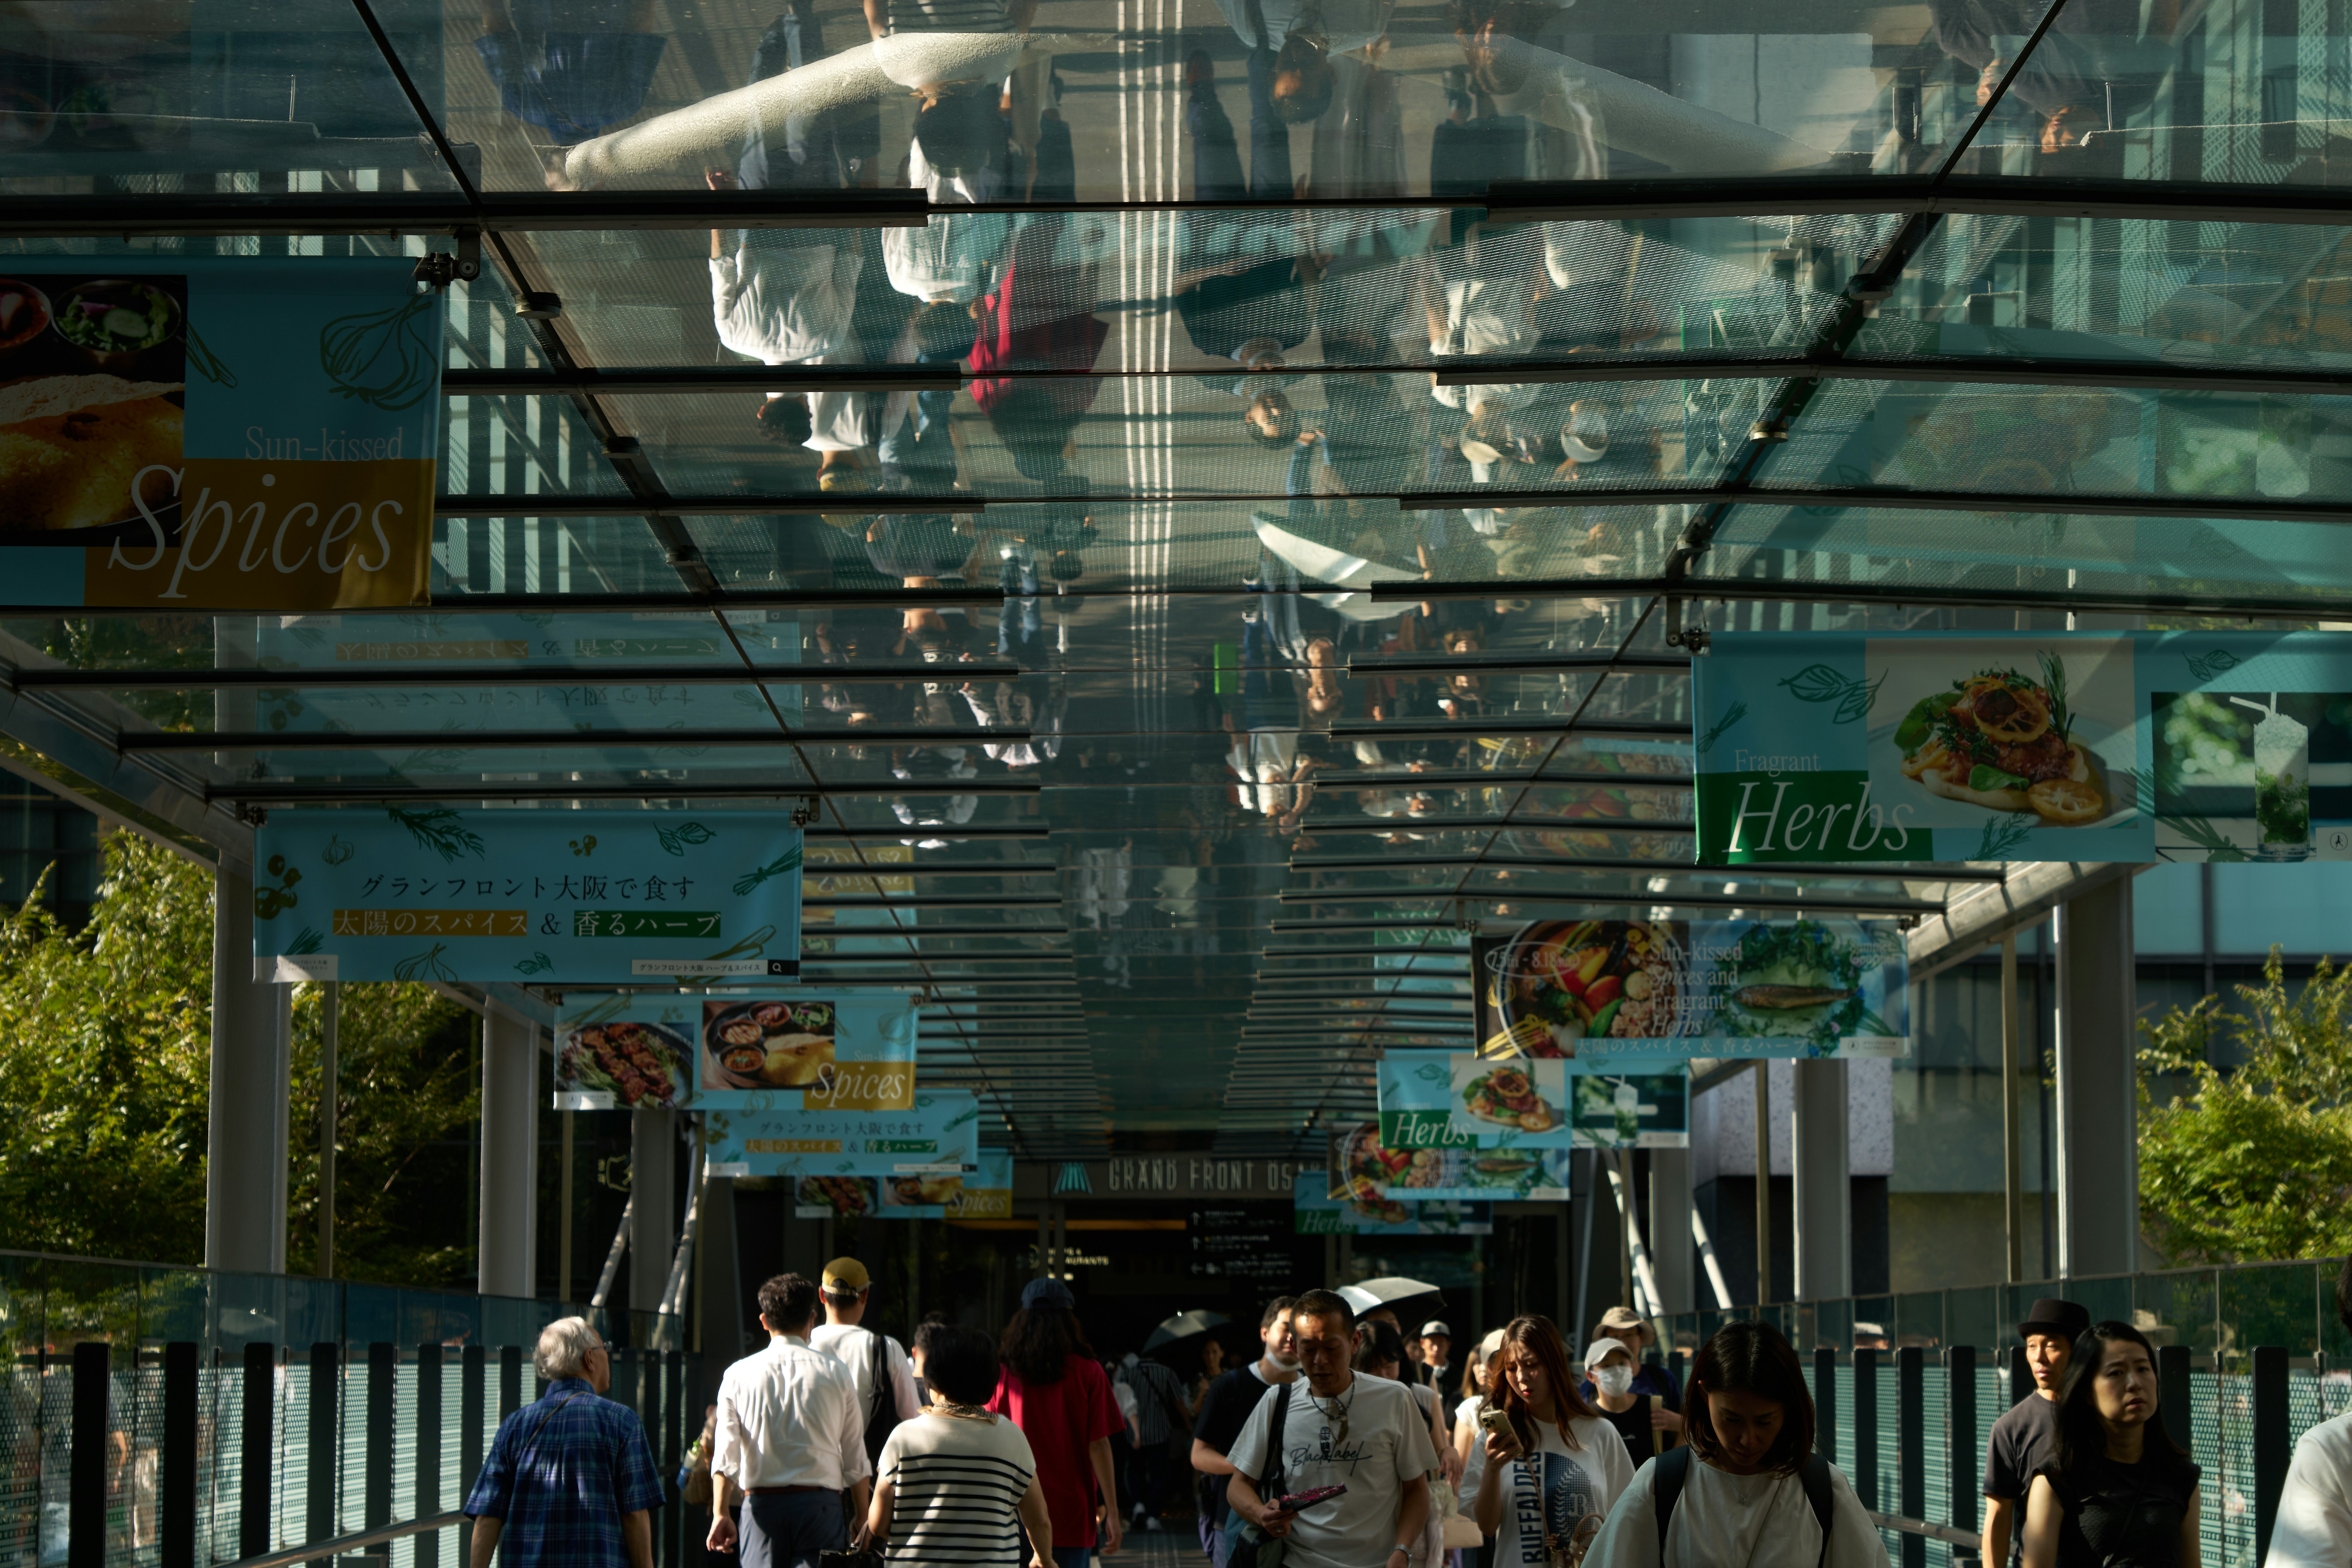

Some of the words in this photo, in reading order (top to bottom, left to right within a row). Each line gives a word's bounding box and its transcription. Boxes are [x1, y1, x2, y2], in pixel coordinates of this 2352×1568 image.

[245, 426, 403, 461] Sun-kissed
[108, 464, 403, 599] Spices
[1734, 750, 1821, 777] Fragrant
[1722, 779, 1914, 853] Herbs
[361, 875, 694, 900] グランフロント大阪で食す
[334, 910, 527, 936] 太陽のスパイス
[541, 913, 562, 935] &
[574, 910, 720, 937] 香るハーブ
[1650, 940, 1742, 961] Sun-kissed
[1650, 968, 1704, 990] Spices
[1707, 969, 1738, 986] and
[1651, 990, 1726, 1013] Fragrant
[1651, 1014, 1703, 1036] Herbs
[854, 1050, 906, 1062] Sun-kissed
[811, 1062, 906, 1108] Spices
[1391, 1113, 1470, 1145] Herbs
[1109, 1159, 1178, 1191] GRAND
[1189, 1159, 1254, 1191] FRONT
[948, 1190, 1006, 1218] Spices
[1302, 1211, 1354, 1232] Herbs
